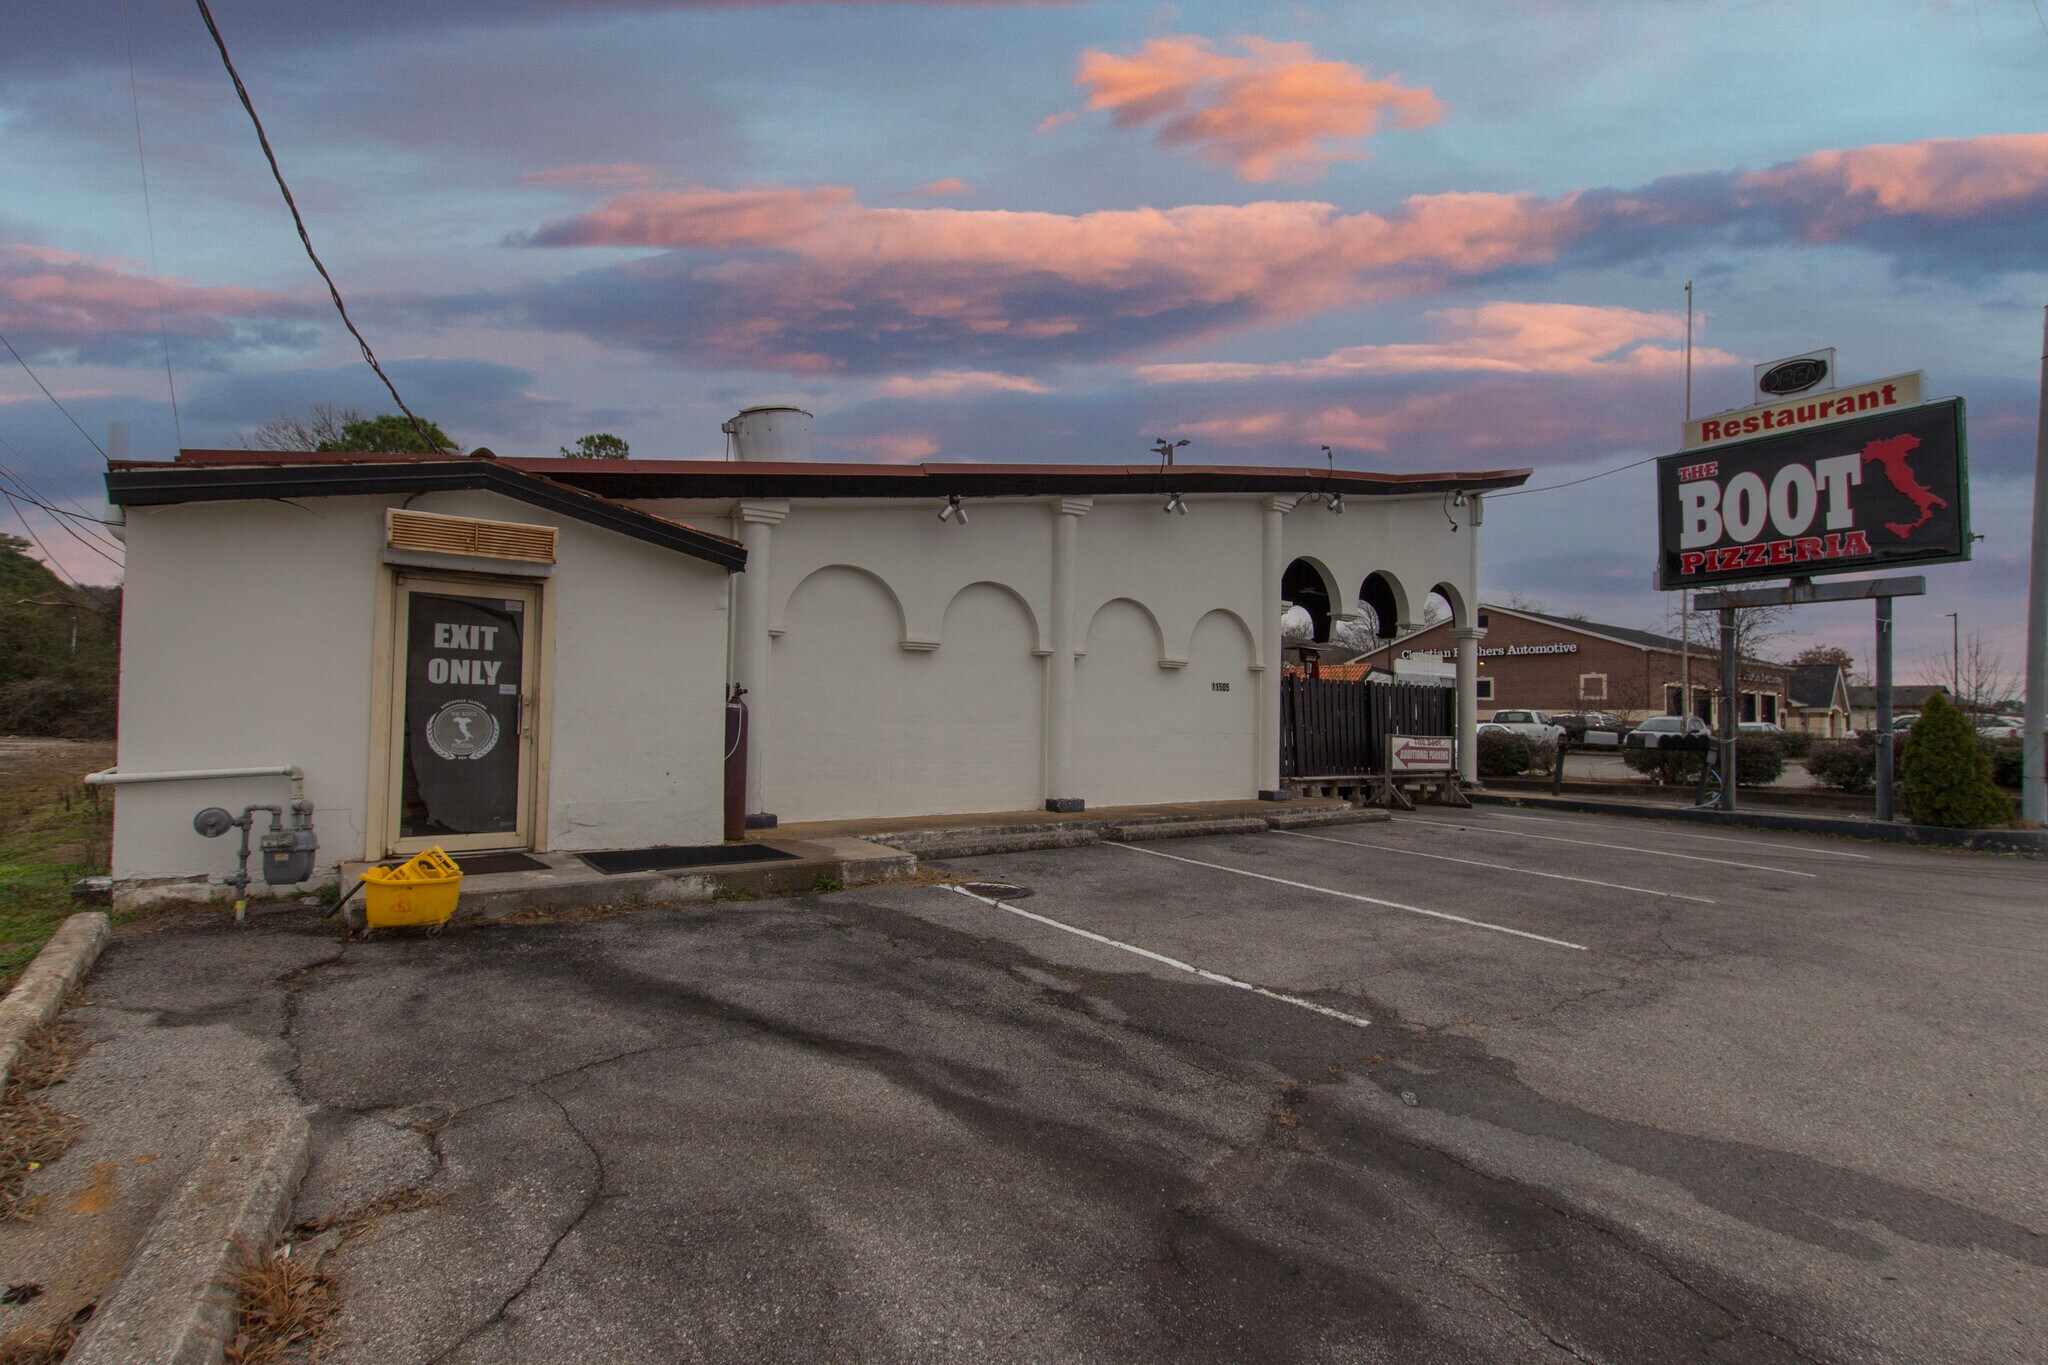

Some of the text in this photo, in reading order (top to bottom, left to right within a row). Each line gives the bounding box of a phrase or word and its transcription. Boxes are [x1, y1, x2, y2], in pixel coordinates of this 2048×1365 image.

[1763, 362, 1823, 390] OPEN
[1702, 384, 1897, 442] Restaurant
[1678, 461, 1718, 482] THE
[1678, 452, 1864, 550] BOOT
[1680, 530, 1872, 575] PIZZERIA
[434, 622, 498, 650] EXIT
[1401, 648, 1452, 660] Cistian
[1453, 646, 1505, 658] Bhers
[1507, 643, 1578, 656] Automotive
[428, 658, 502, 686] ONLY
